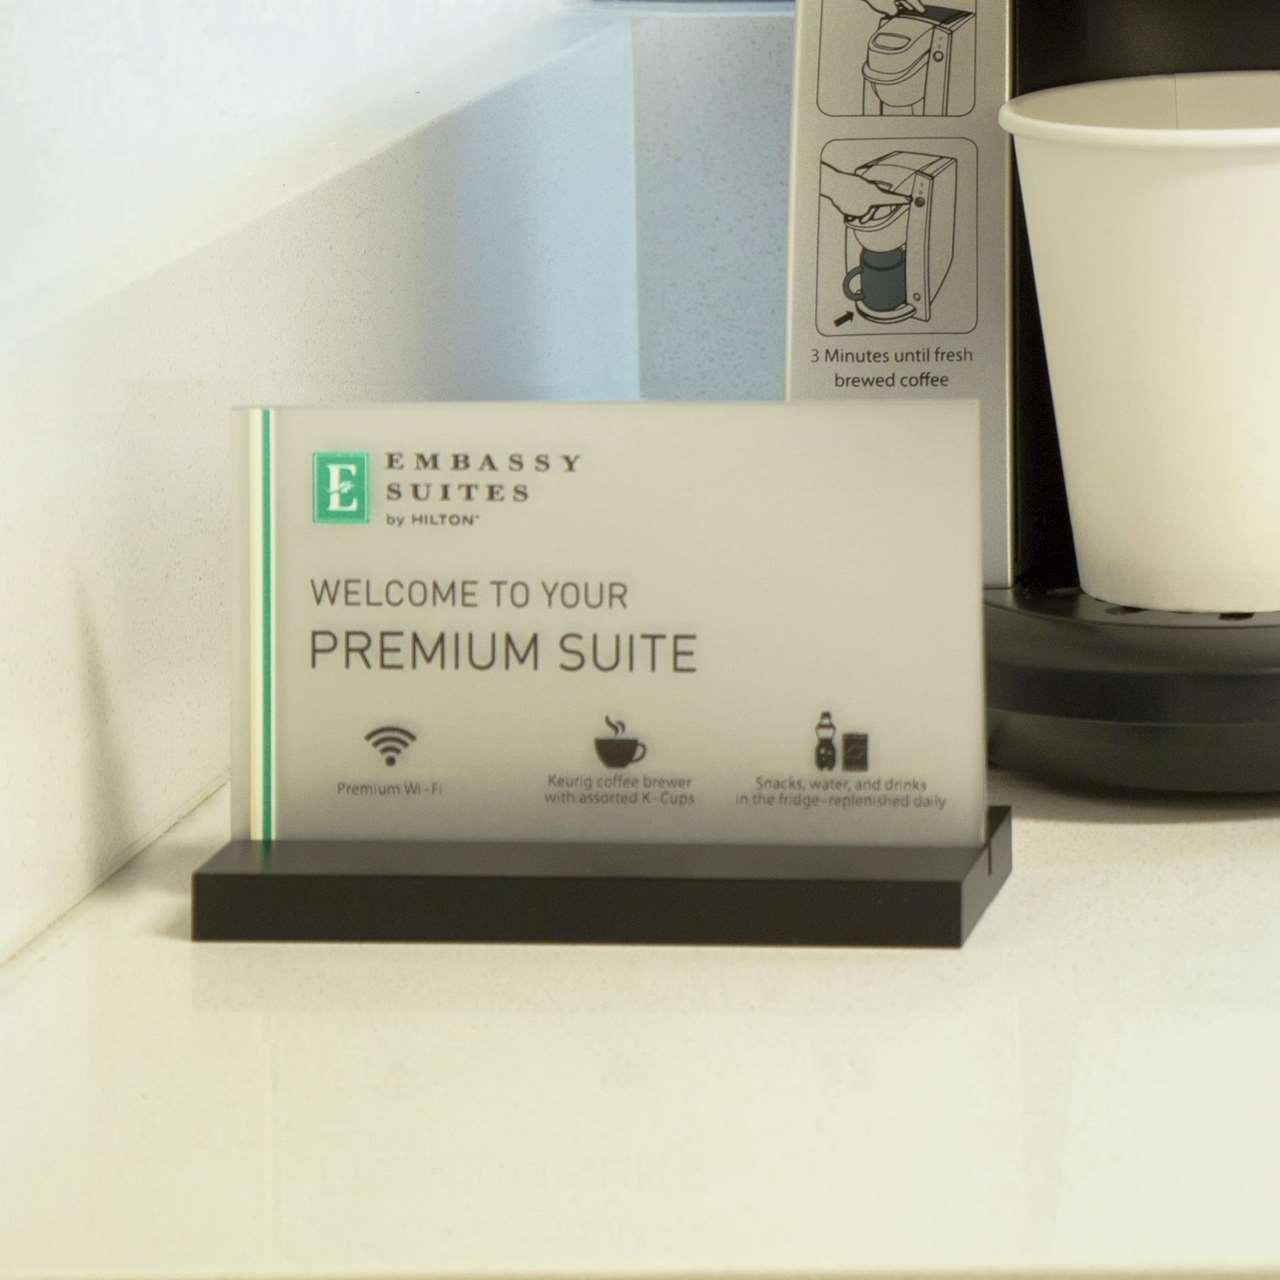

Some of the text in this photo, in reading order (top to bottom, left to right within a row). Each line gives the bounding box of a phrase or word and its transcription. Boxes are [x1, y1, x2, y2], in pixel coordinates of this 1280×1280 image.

[810, 346, 973, 363] 3 Minutes until fresh
[834, 371, 949, 388] brewed coffee
[386, 452, 580, 472] EMBASSY
[386, 482, 529, 502] SUITES
[386, 514, 475, 527] by HILTON
[310, 578, 629, 609] WELCOME TO YOUR
[310, 630, 698, 673] PREMIUM SUITE
[336, 782, 400, 796] Premium
[548, 773, 692, 791] Keurig coffee brewer
[854, 778, 881, 792] and
[884, 778, 927, 792] drinks
[545, 791, 576, 805] with
[579, 791, 638, 805] assorted
[752, 793, 775, 807] the
[912, 794, 947, 810] daily
